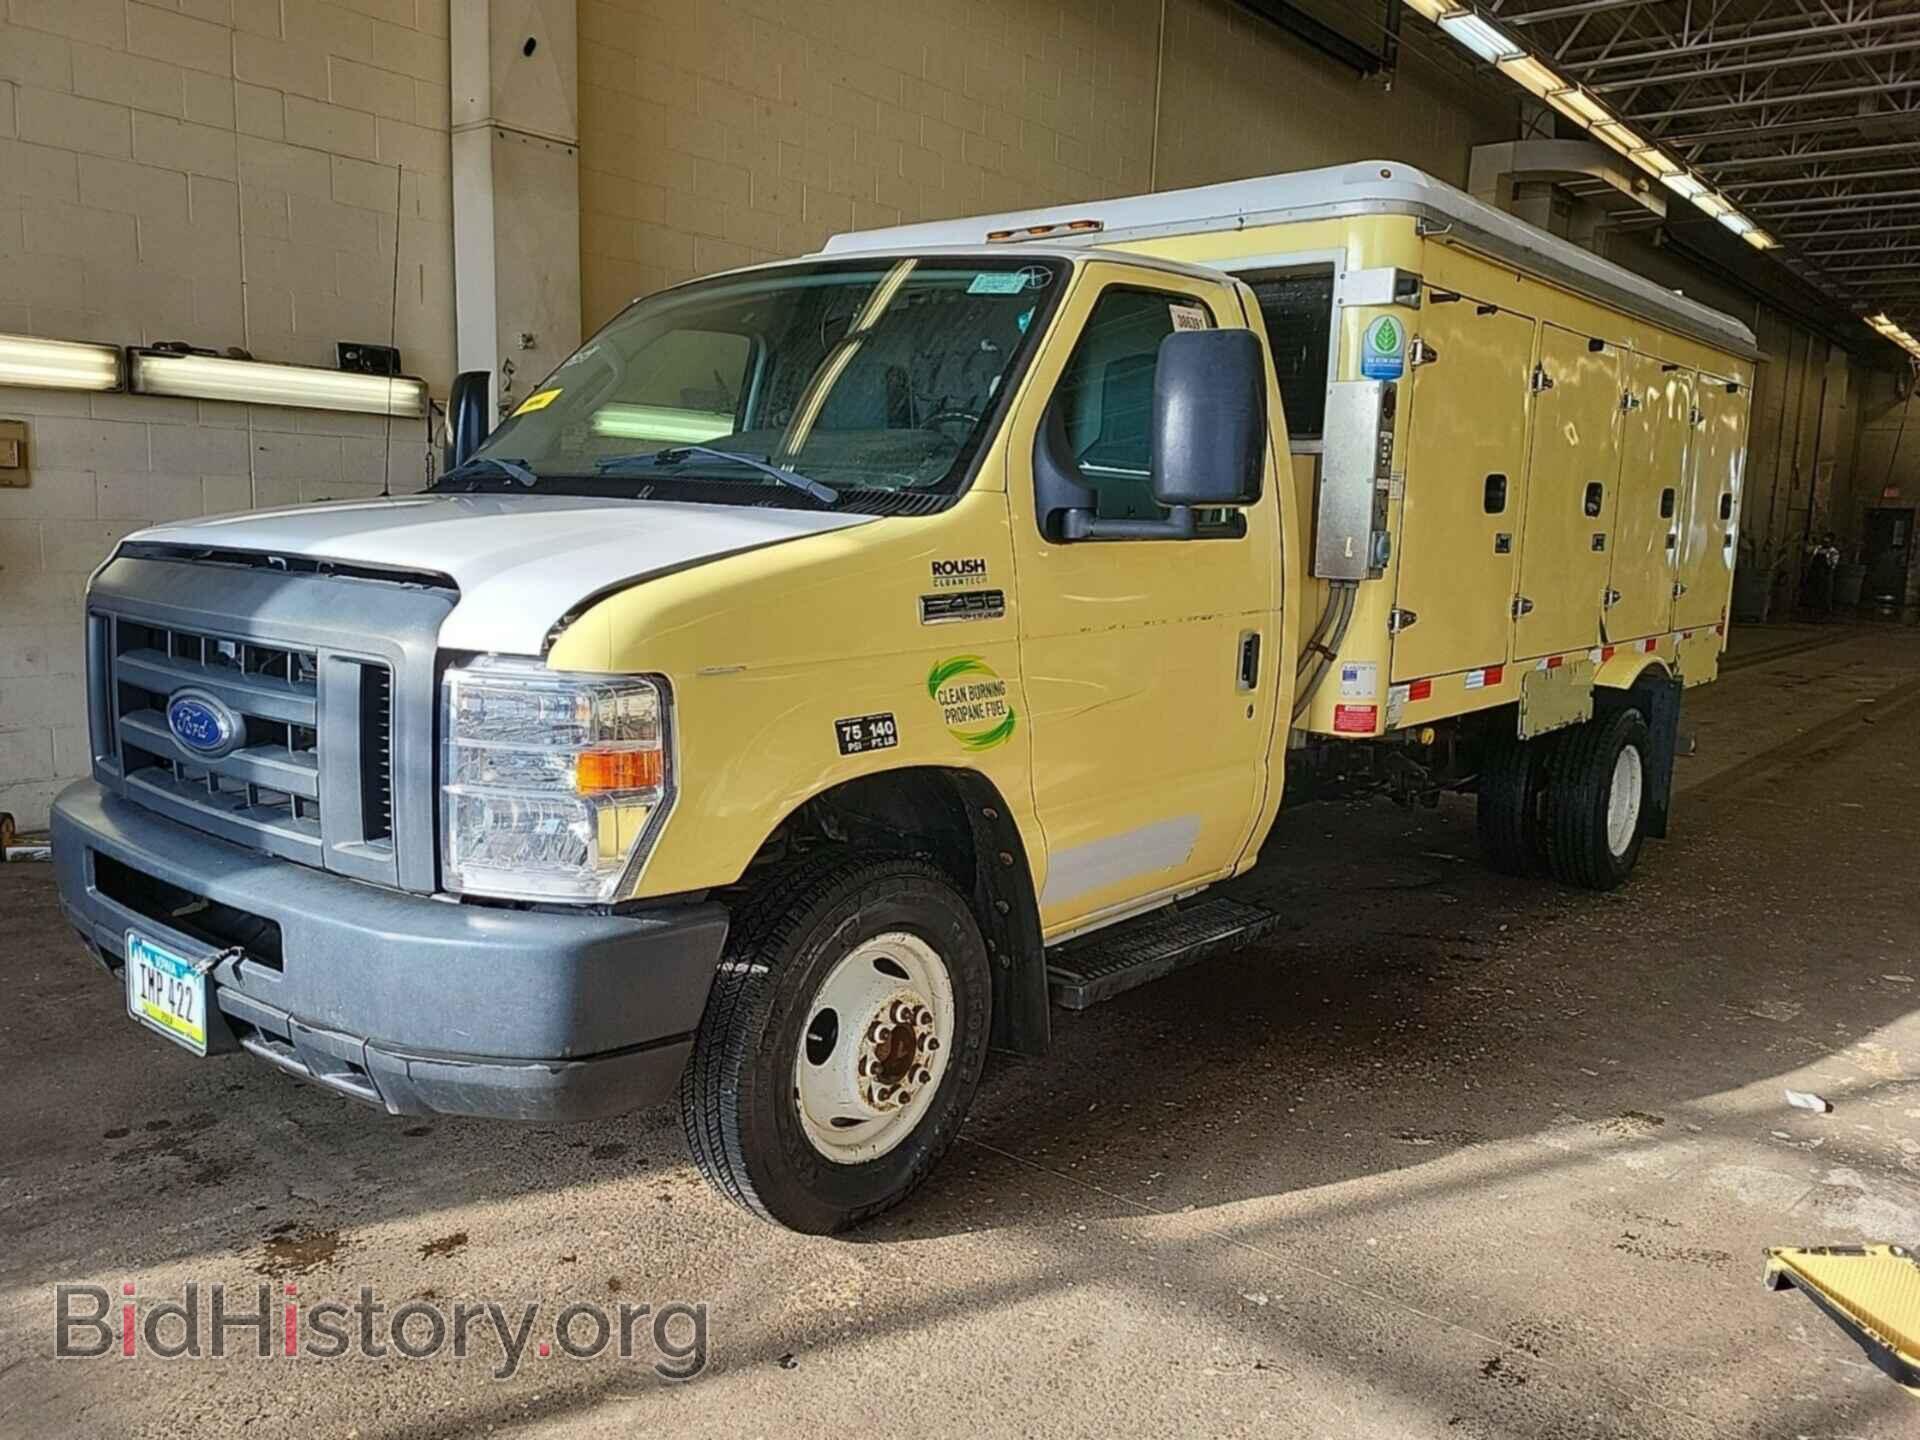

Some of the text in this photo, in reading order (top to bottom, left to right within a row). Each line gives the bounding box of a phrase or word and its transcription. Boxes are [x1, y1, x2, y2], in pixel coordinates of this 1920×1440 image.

[932, 559, 986, 575] ROUSH
[938, 680, 1006, 706] CLEAN BURNING
[176, 706, 209, 739] Ford
[944, 699, 1006, 725] PROPANE FUEL
[841, 720, 894, 742] 75 140
[168, 978, 193, 1023] 422
